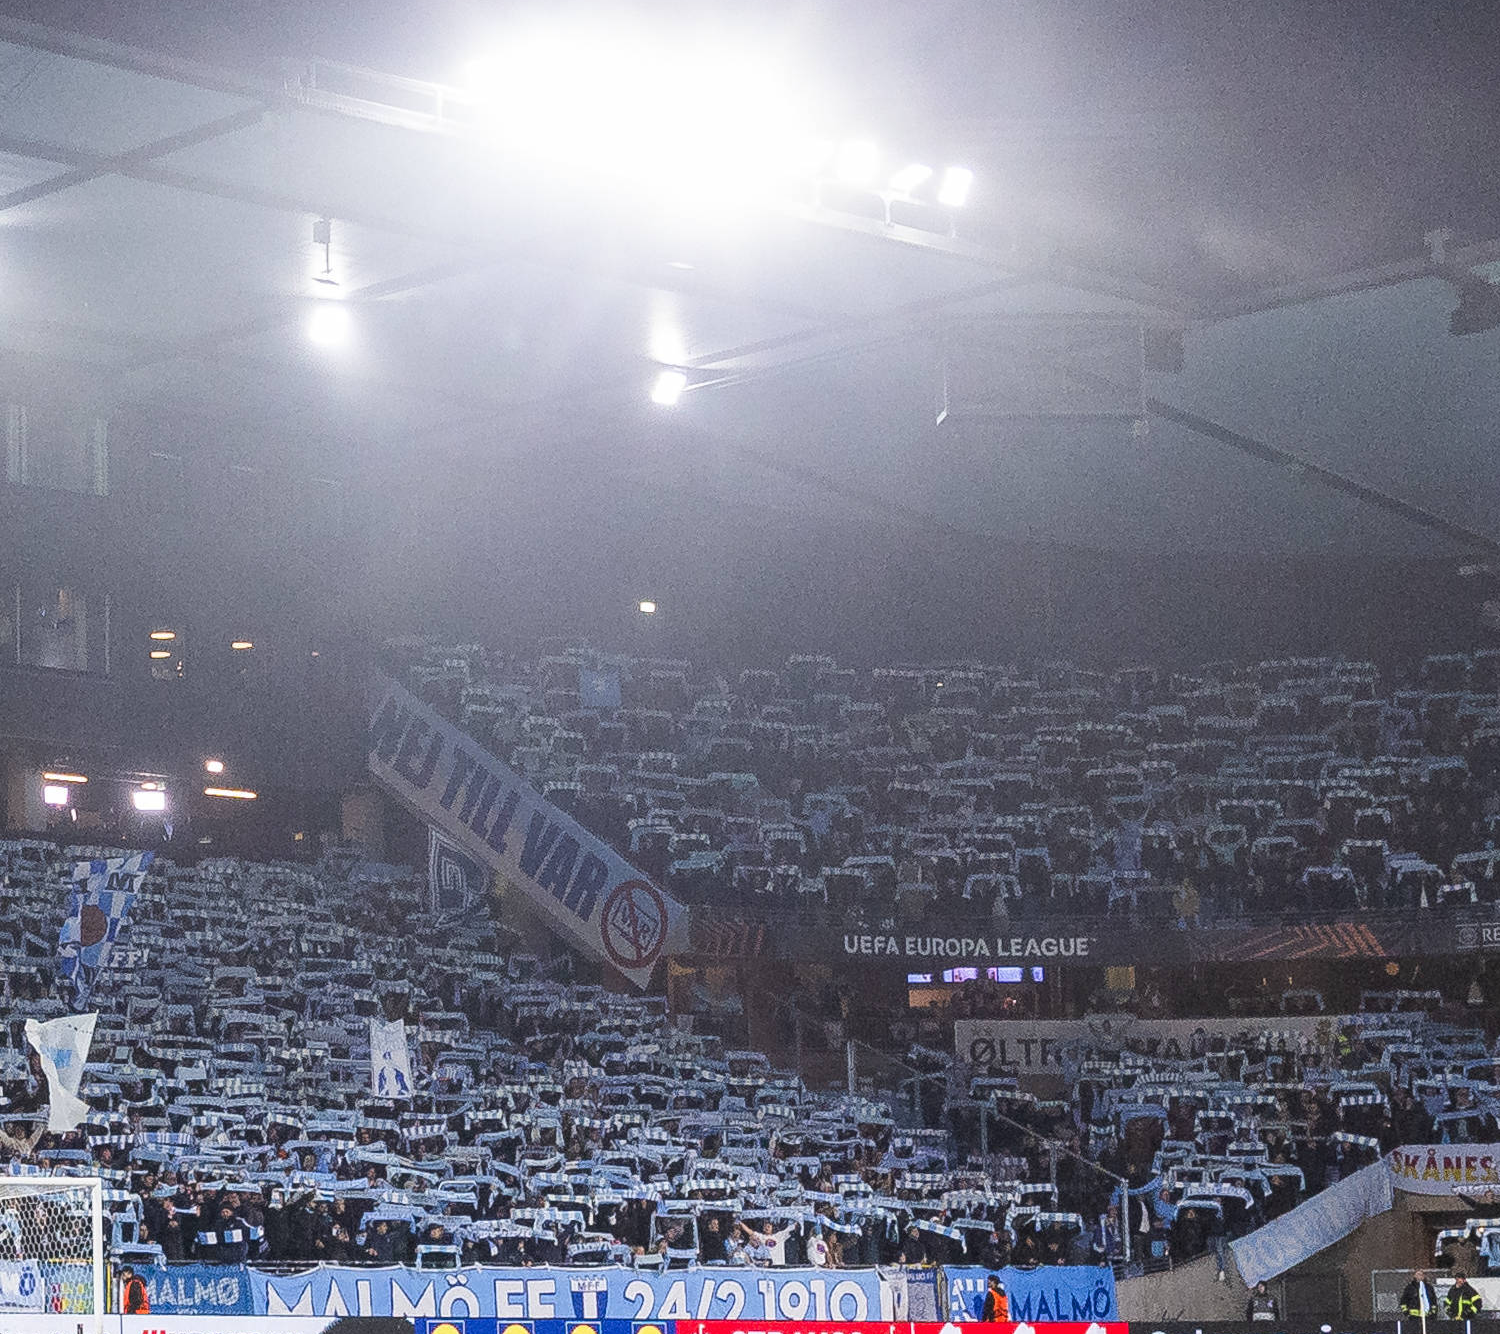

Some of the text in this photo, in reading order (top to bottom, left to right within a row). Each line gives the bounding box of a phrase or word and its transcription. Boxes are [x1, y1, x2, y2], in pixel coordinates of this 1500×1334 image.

[518, 810, 609, 923] VAR
[843, 935, 1090, 957] UEFA EUROPA LEAGUE
[266, 1273, 869, 1321] MALMÖ FF 24/2 1910
[1010, 1278, 1111, 1322] MALMÖ
